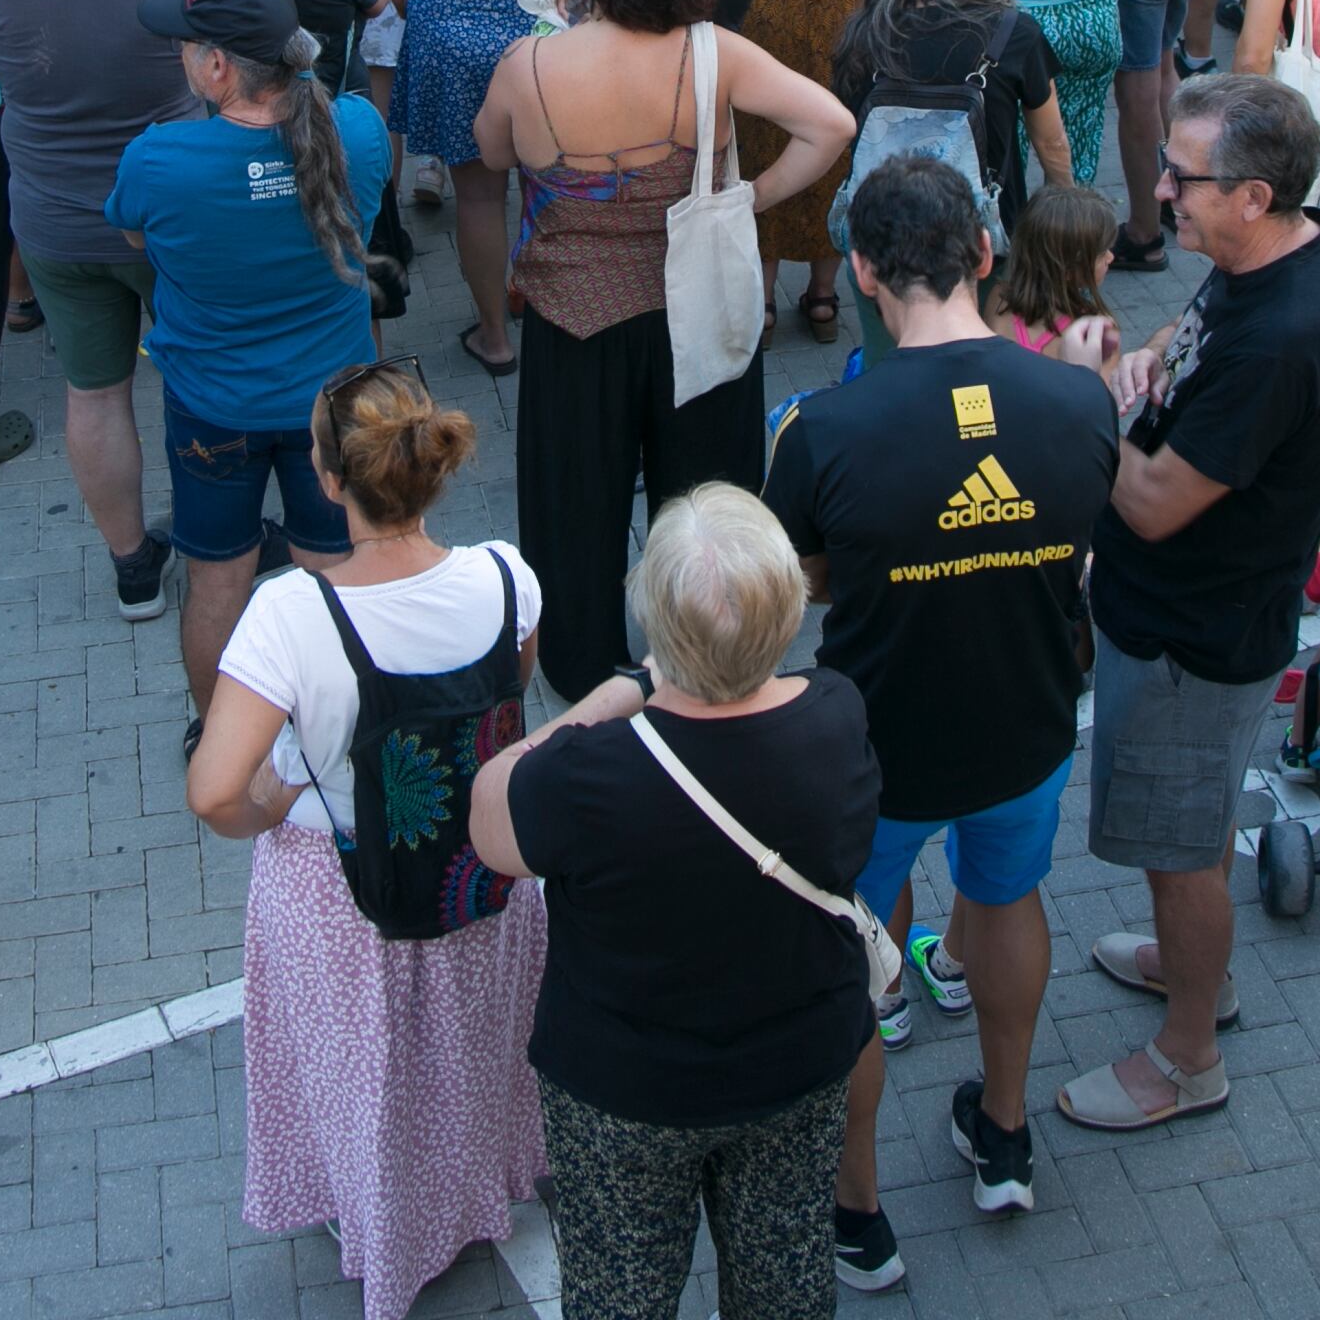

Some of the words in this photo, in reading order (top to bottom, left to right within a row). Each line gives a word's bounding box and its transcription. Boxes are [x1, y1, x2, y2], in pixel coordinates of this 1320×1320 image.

[248, 175, 296, 188] PROTECTING
[250, 190, 278, 201] SINCE
[278, 186, 299, 197] 1967
[959, 422, 996, 433] Comunidad
[960, 432, 970, 440] de
[970, 428, 998, 438] Madrid
[938, 498, 1036, 531] adidas
[889, 544, 1075, 583] #WHYIRUNMADRID
